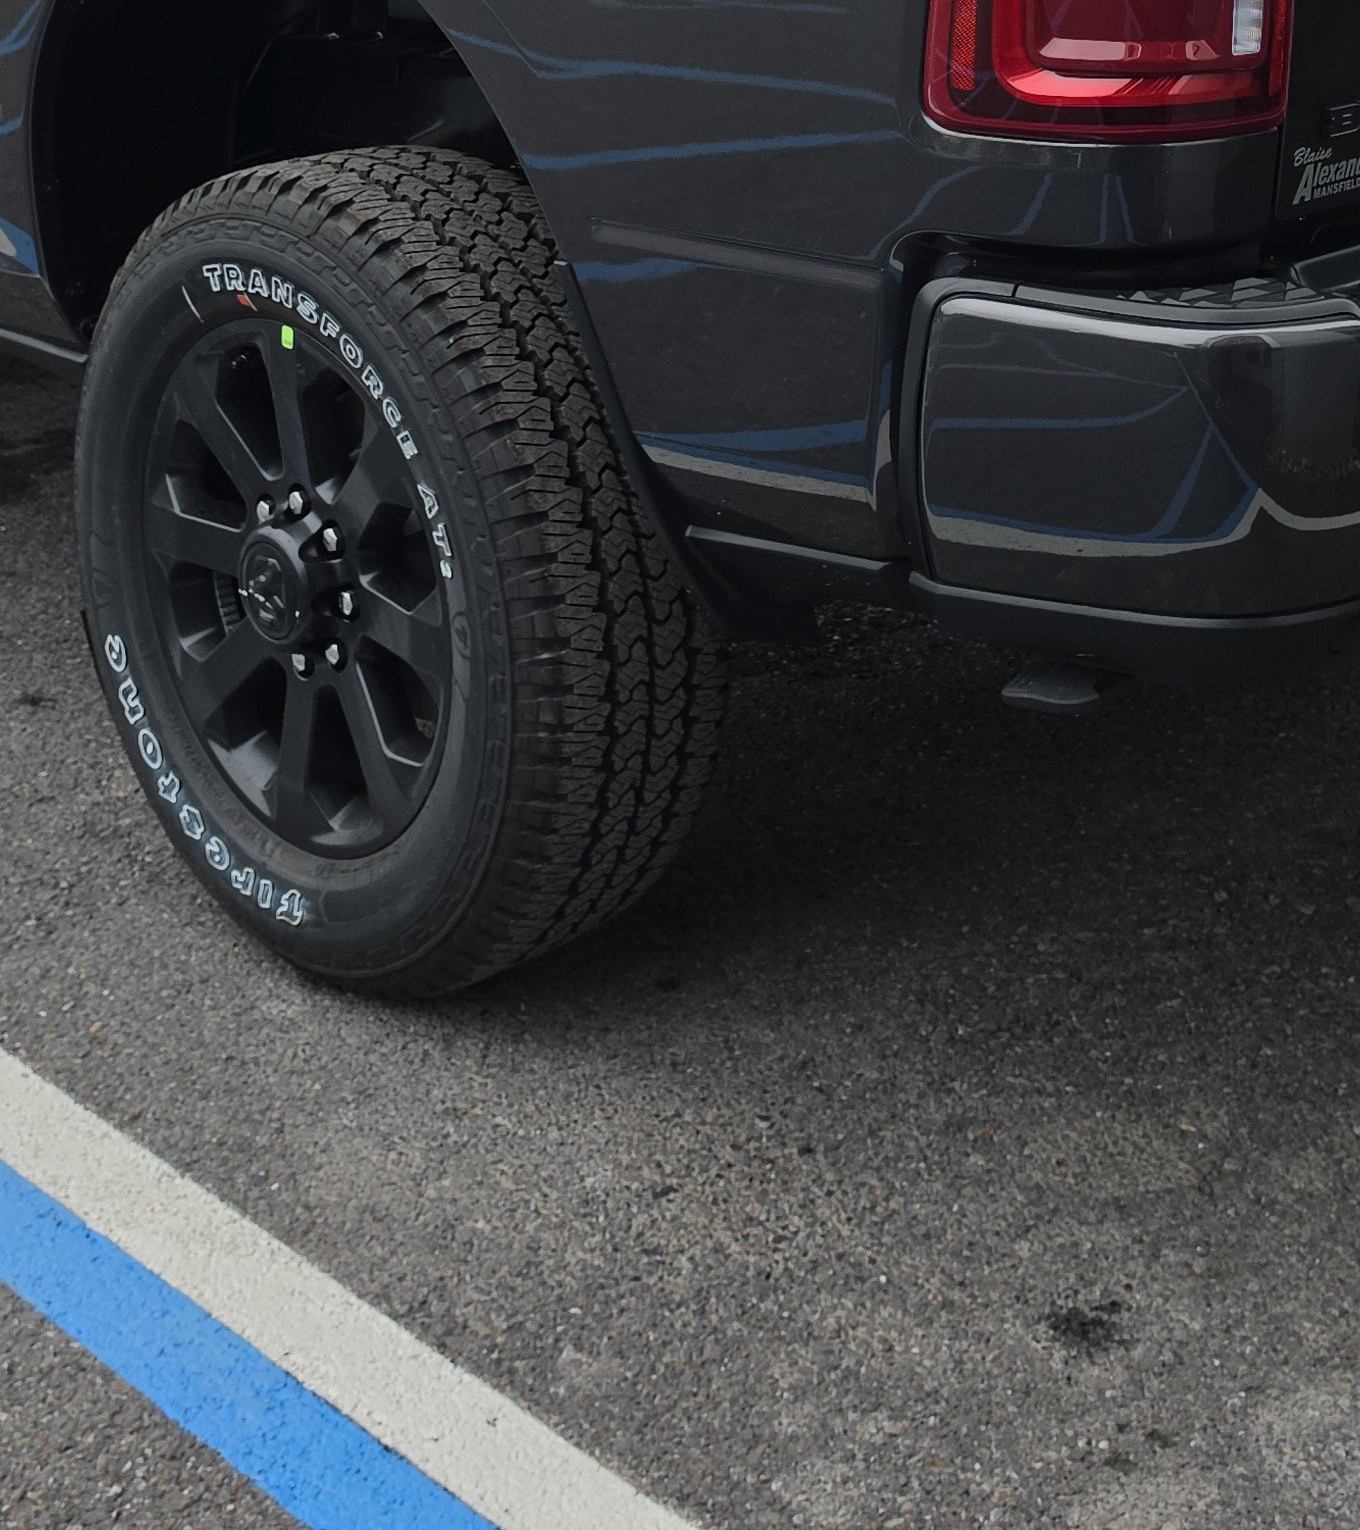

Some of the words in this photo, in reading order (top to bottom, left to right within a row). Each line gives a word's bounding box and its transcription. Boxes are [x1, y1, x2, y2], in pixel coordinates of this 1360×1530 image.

[1293, 146, 1334, 167] Blaise
[202, 263, 419, 460] TRANSFORCE
[104, 633, 305, 926] Firestone
